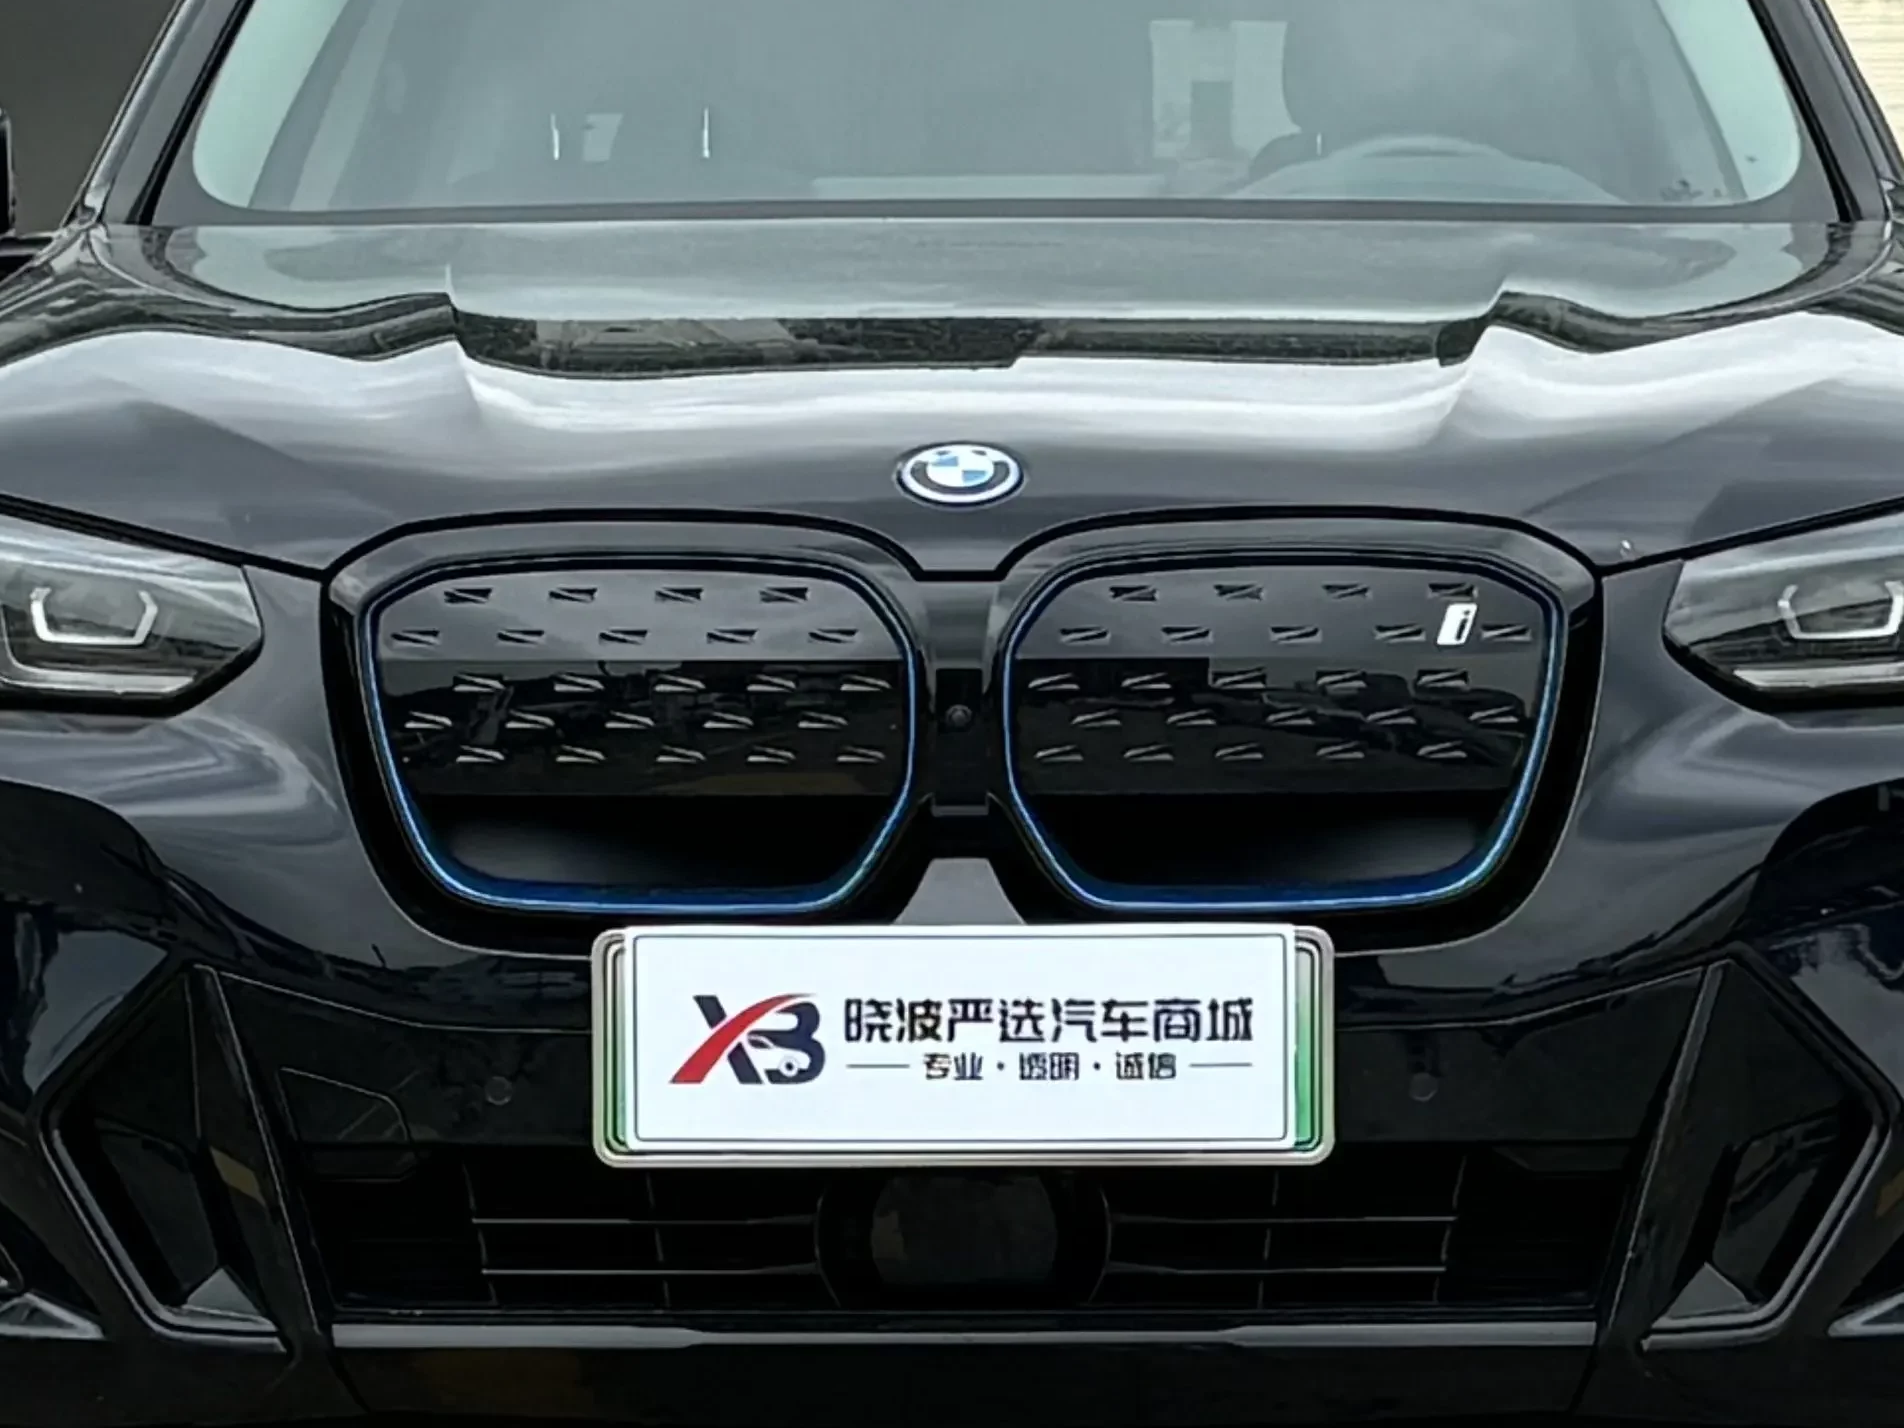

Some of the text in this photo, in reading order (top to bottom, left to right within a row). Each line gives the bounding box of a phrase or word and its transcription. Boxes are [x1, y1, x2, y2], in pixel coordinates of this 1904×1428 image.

[844, 997, 1253, 1043] 晓波严选汽车商城
